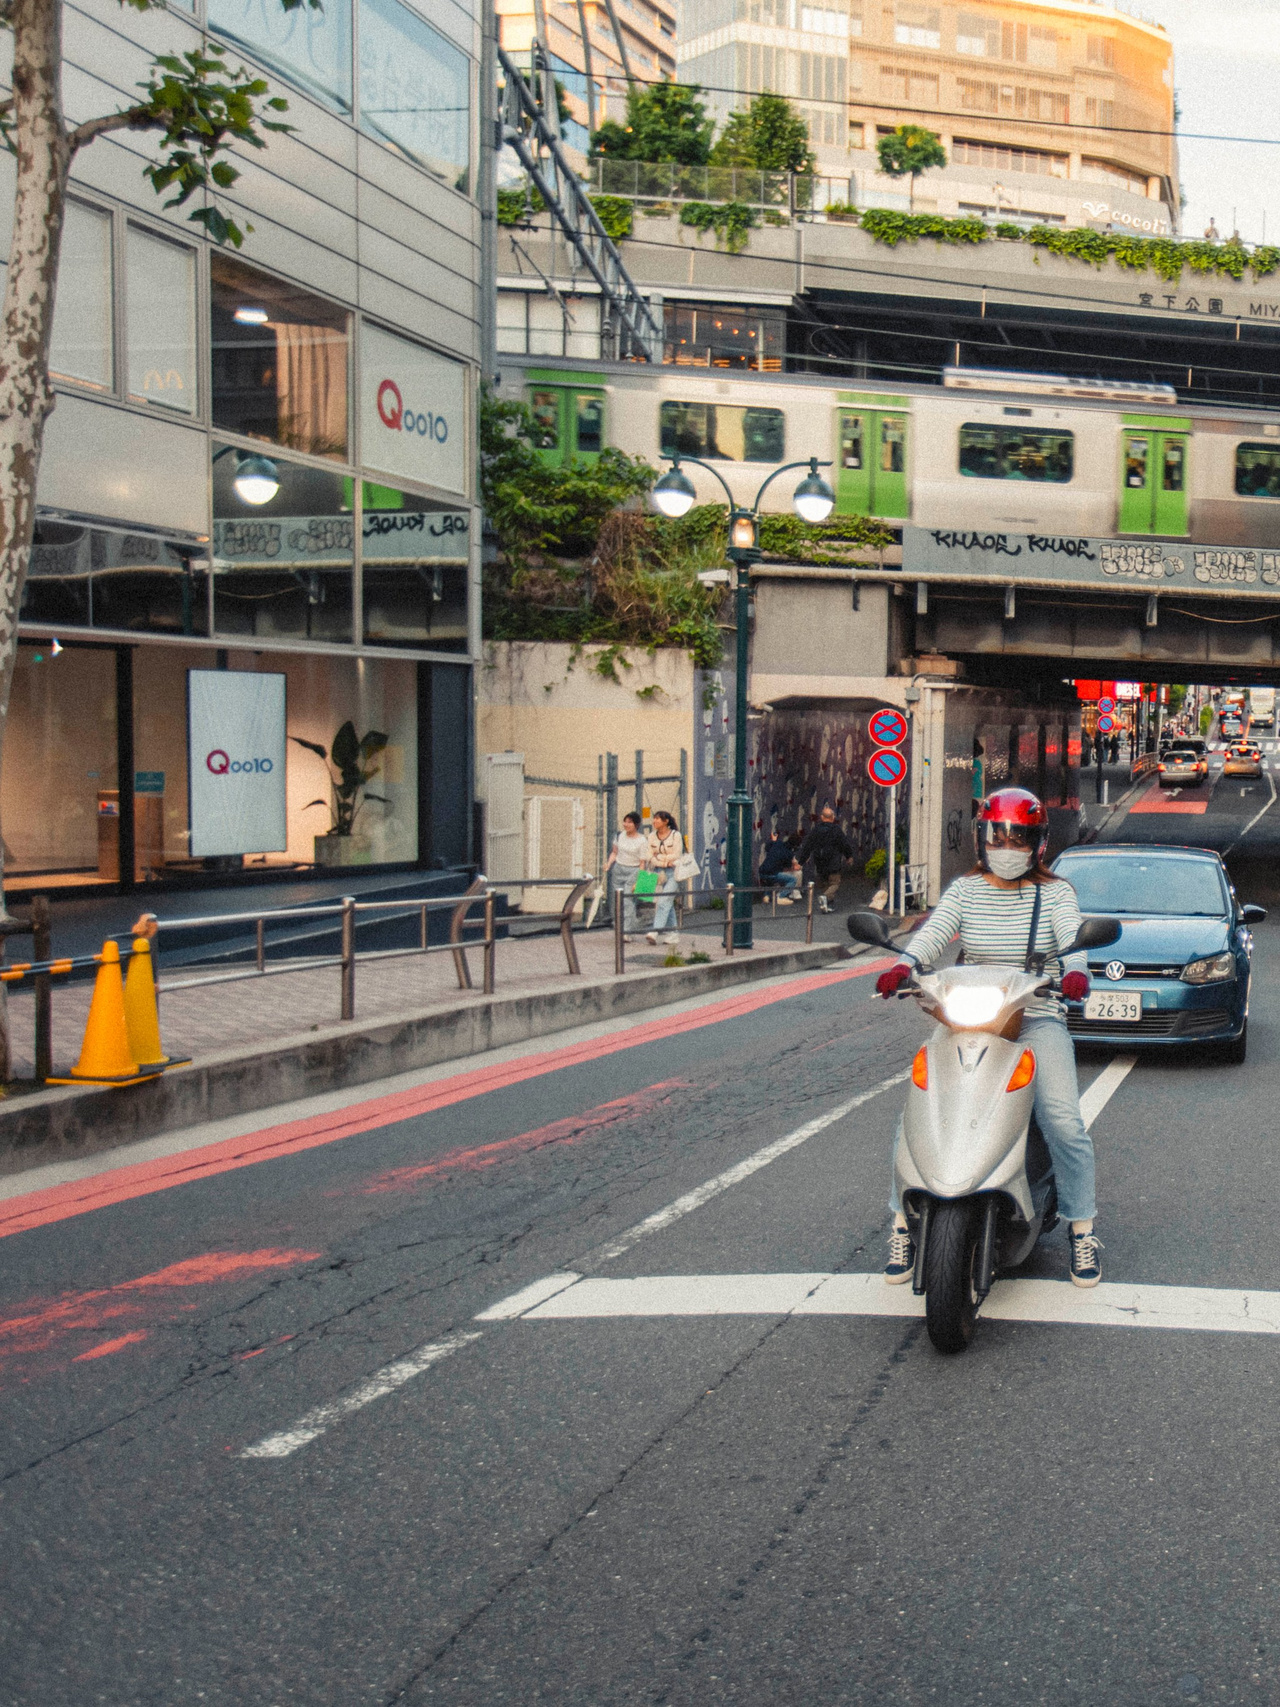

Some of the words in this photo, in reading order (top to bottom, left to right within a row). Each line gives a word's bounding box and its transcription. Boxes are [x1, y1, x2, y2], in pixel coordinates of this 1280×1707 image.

[1111, 210, 1167, 235] cocoti
[1139, 292, 1223, 314] 宮下公園
[377, 378, 448, 443] Qoo10
[206, 749, 274, 775] Qoo10
[1098, 1003, 1137, 1018] 26-39
